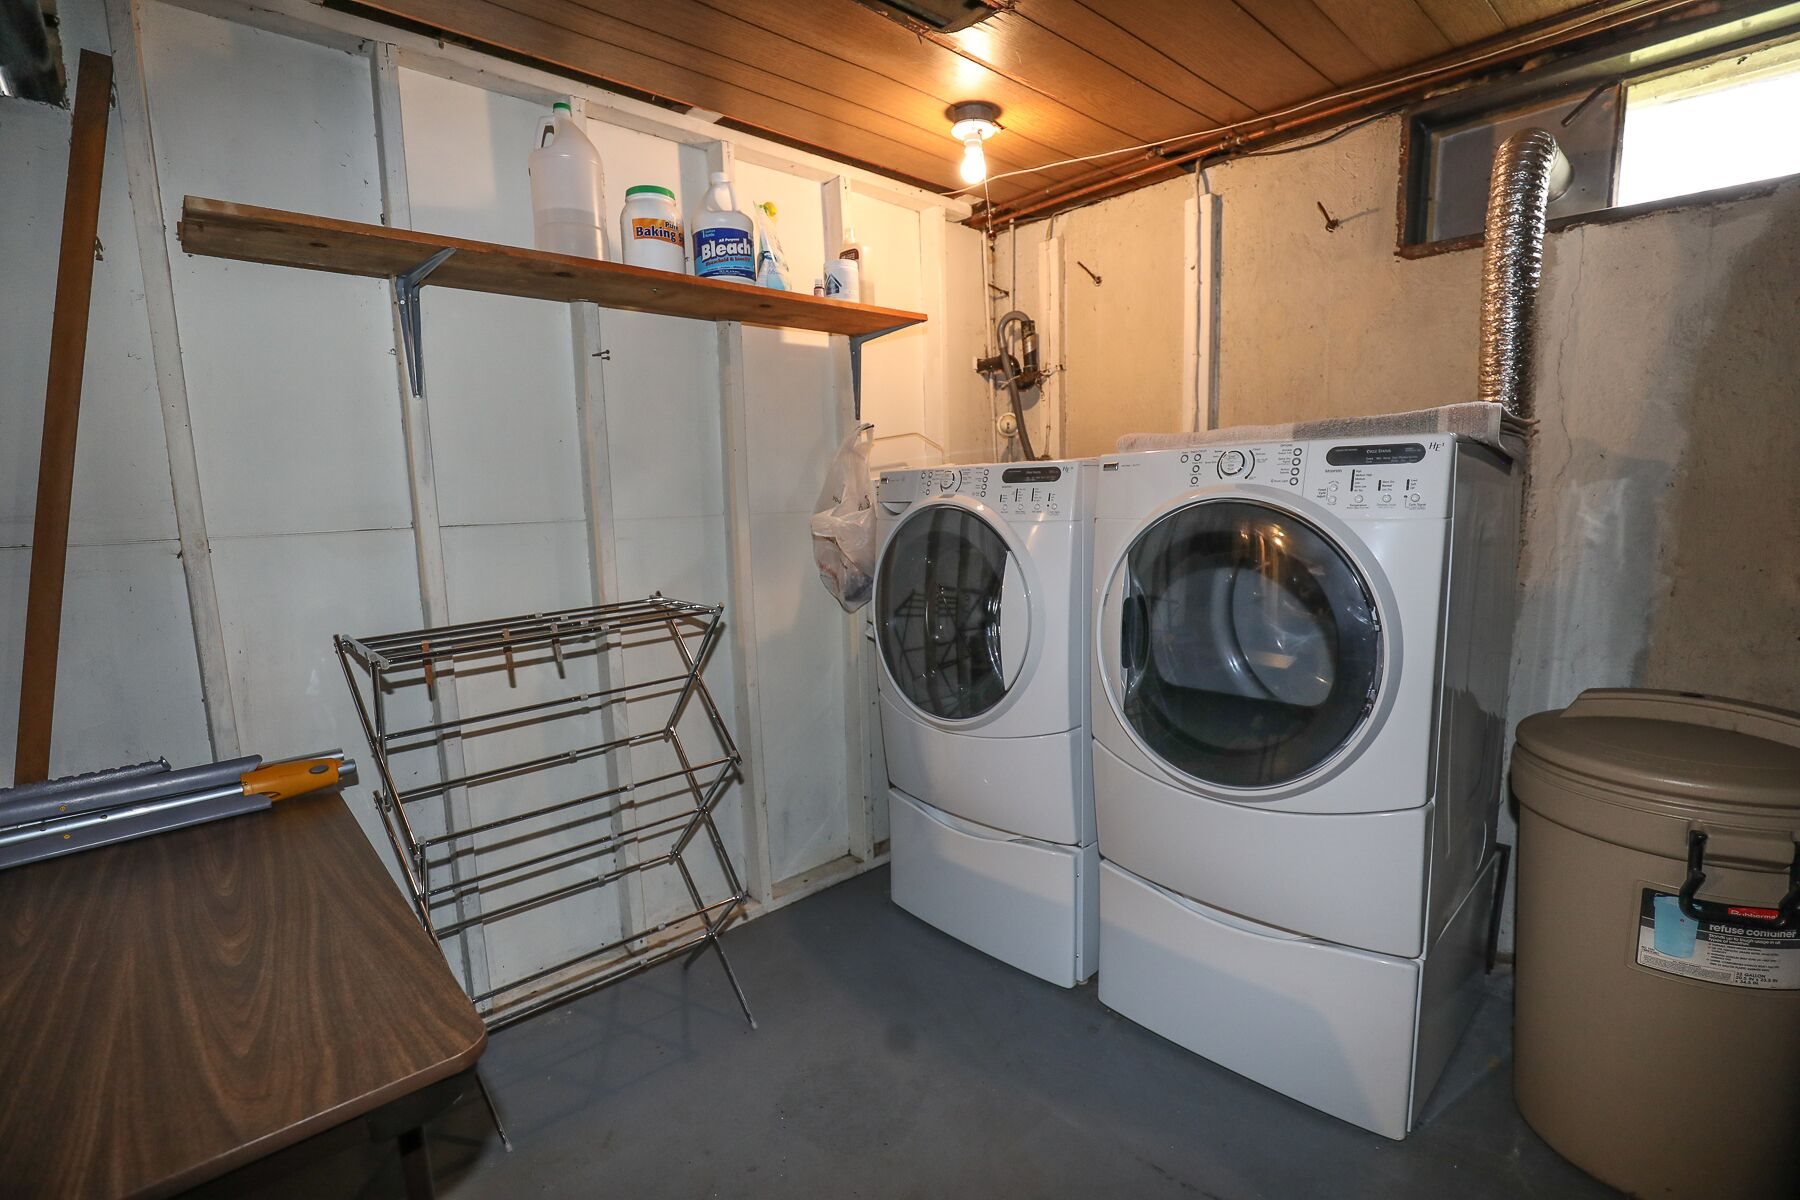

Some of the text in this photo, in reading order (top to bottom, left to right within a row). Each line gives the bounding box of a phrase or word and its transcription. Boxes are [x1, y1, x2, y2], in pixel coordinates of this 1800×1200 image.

[636, 226, 676, 243] Baking
[701, 238, 751, 262] Bleach
[1709, 924, 1745, 935] refuse
